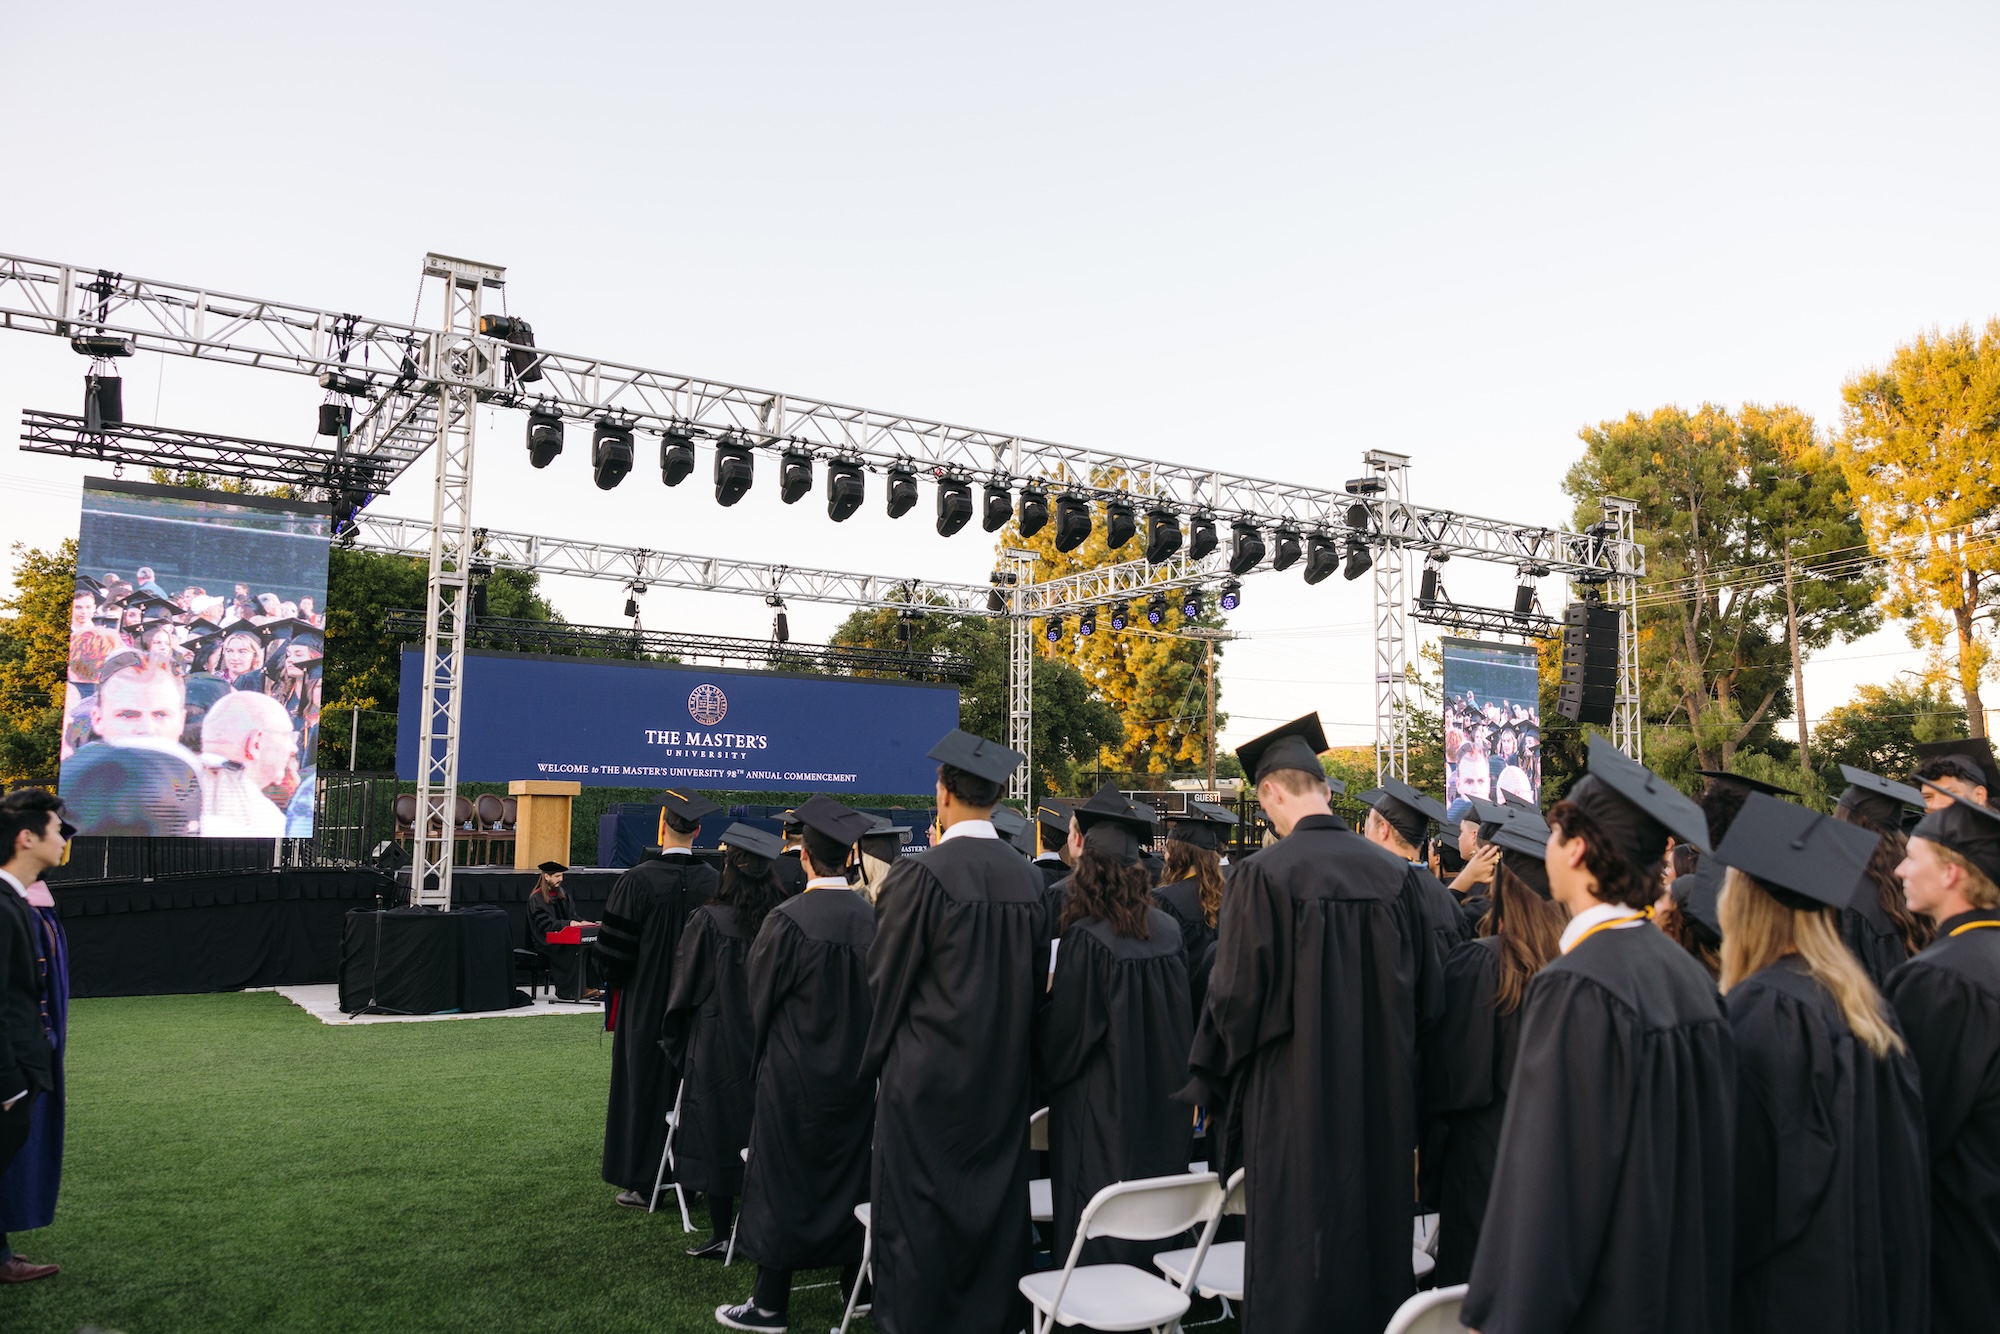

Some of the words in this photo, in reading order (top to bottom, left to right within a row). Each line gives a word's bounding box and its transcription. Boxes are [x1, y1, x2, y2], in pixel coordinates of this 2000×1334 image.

[645, 730, 681, 745] THE
[685, 732, 768, 749] MASTER'S
[666, 749, 747, 760] UNIVERSITY
[537, 763, 589, 773] WELCOME
[591, 766, 599, 774] to
[600, 765, 620, 774] THE
[622, 766, 668, 776] MASTER'S
[669, 768, 725, 778] UNIVERSITY
[746, 771, 782, 780] ANNUAL
[783, 772, 858, 782] COMMENCEMENT
[1194, 794, 1218, 802] GUEST
